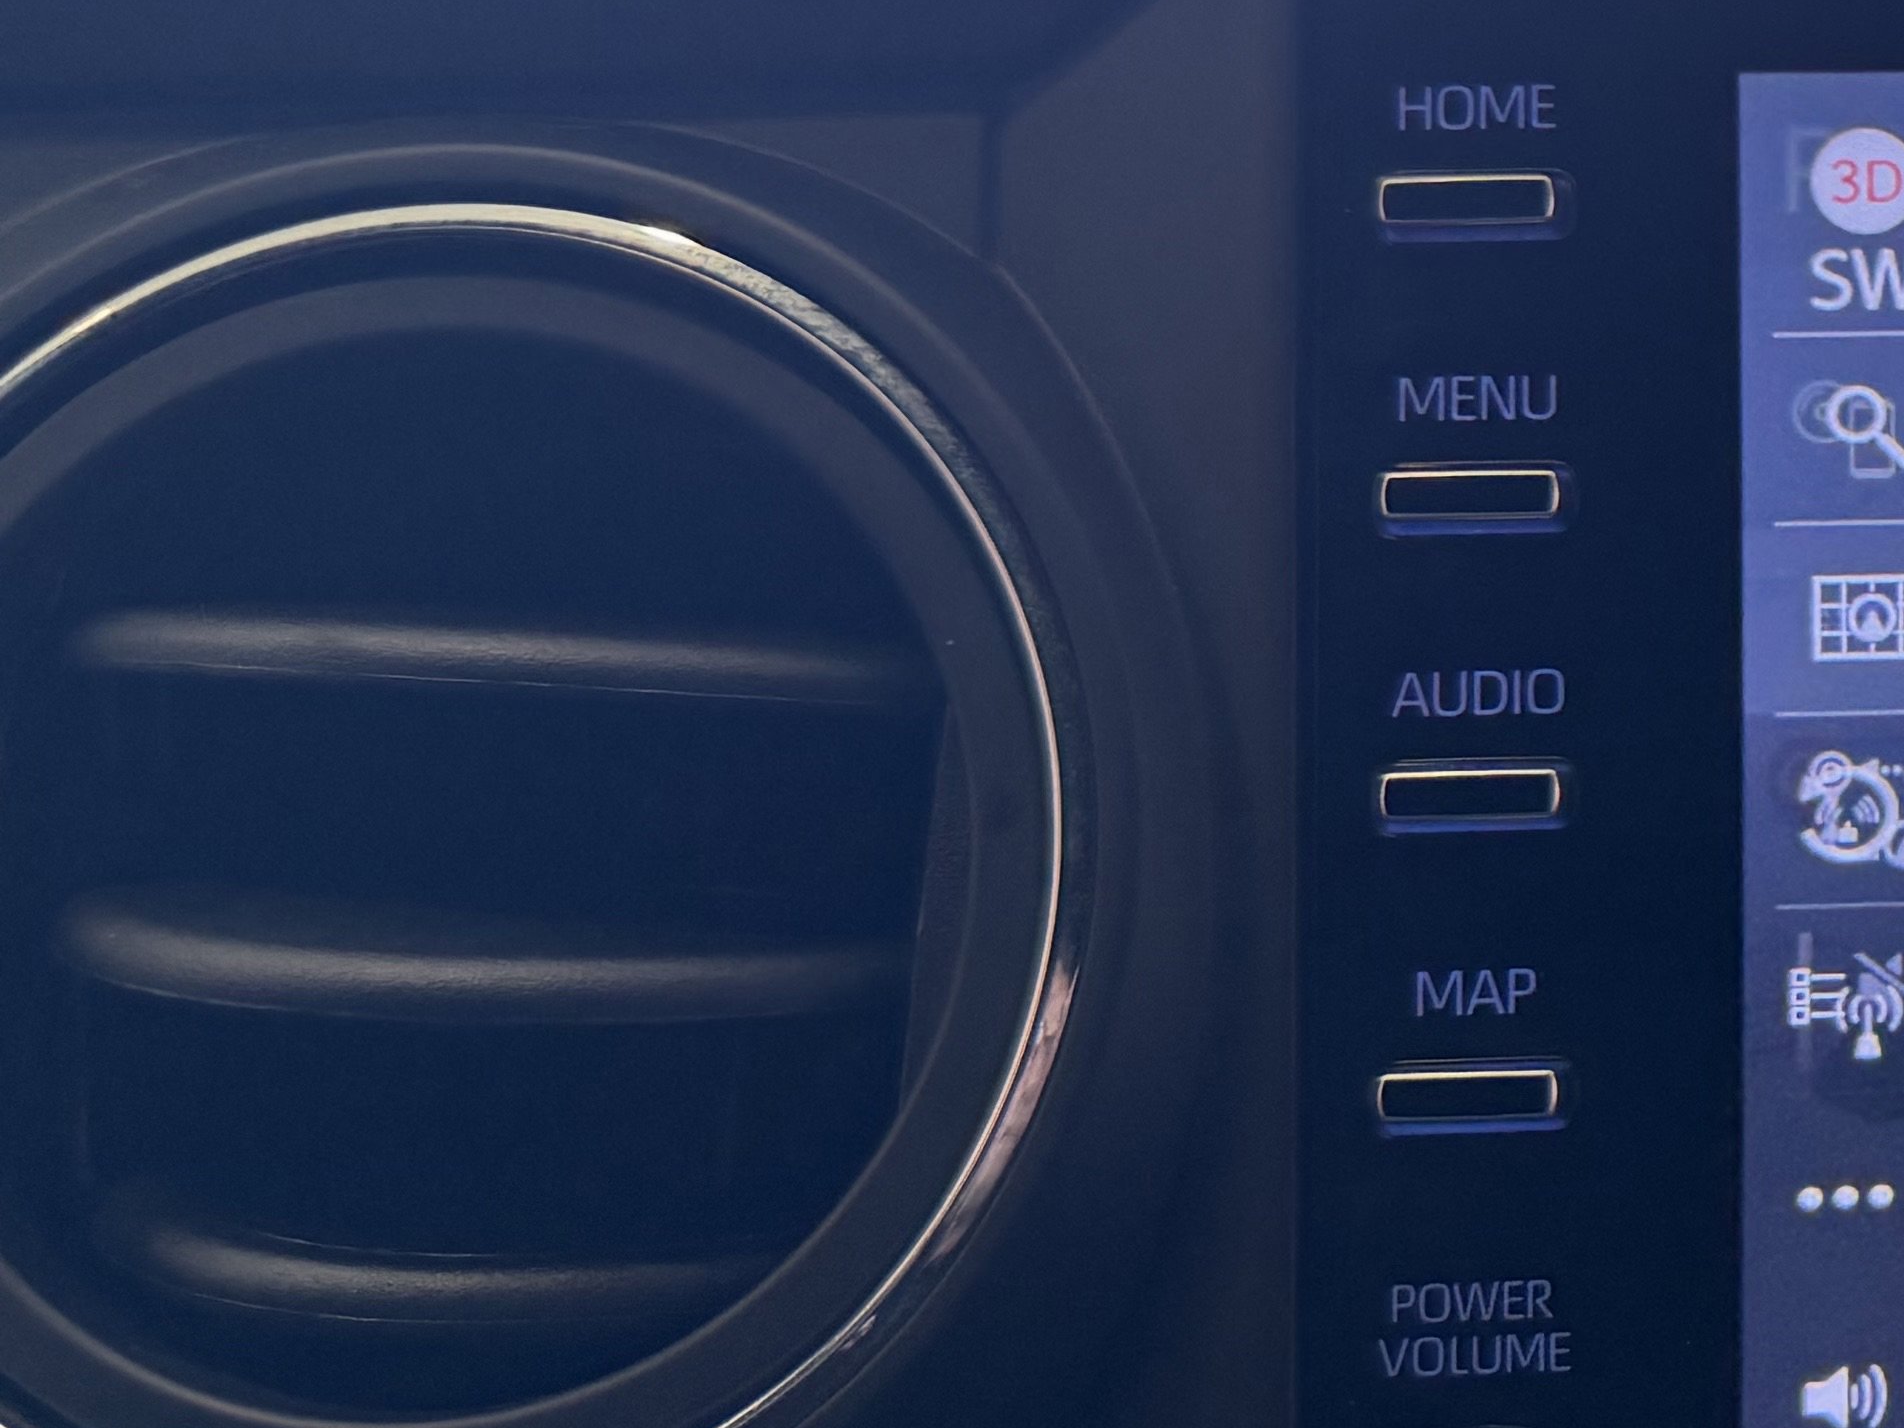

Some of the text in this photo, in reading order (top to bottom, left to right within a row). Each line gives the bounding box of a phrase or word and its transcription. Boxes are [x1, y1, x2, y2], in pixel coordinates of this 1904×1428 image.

[1398, 84, 1556, 131] HOME
[1830, 158, 1904, 205] 3D
[1398, 375, 1558, 422] MENU
[1391, 668, 1567, 718] AUDIO
[1414, 968, 1538, 1017] MAP
[1391, 1278, 1555, 1324] POWER
[1378, 1332, 1572, 1377] VOLUME
